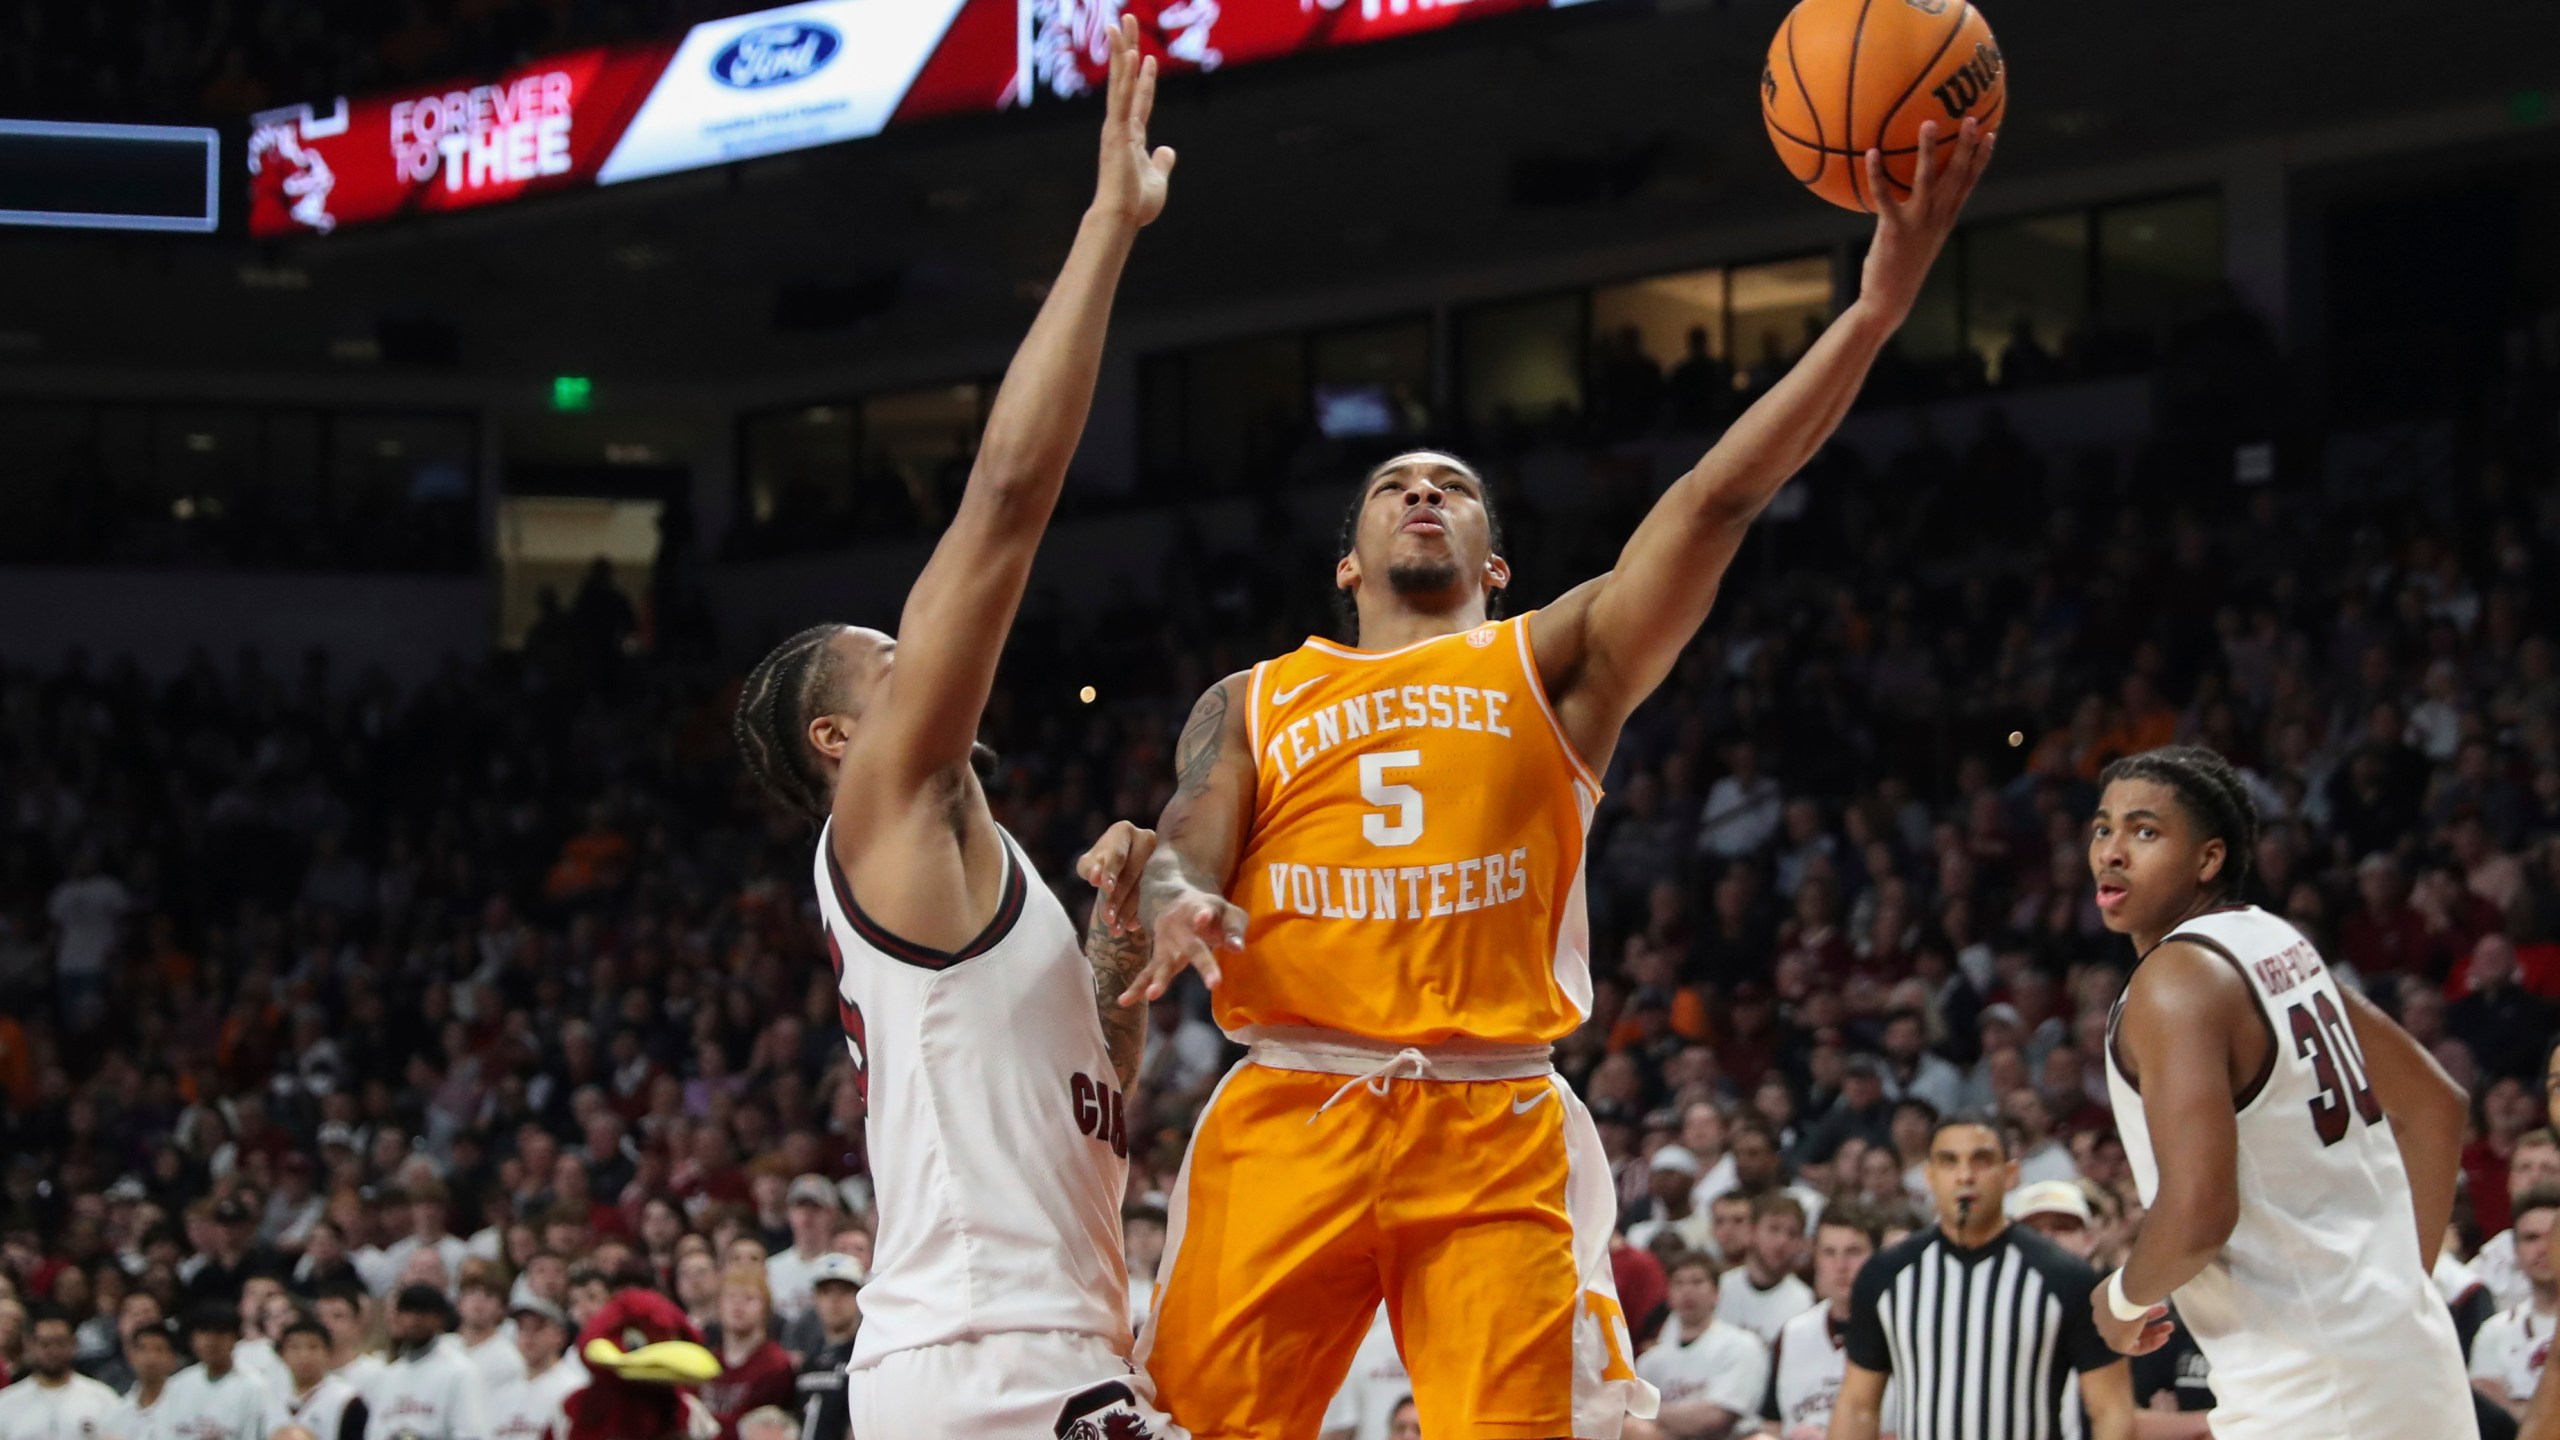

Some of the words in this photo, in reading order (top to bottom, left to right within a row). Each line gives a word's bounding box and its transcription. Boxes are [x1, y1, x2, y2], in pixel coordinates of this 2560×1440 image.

[728, 24, 823, 87] Ford
[390, 71, 573, 150] FOREVER
[394, 139, 440, 183] TO
[437, 114, 573, 193] THEE
[1267, 684, 1512, 785] TENNESSEE
[1358, 749, 1424, 848] 5
[1268, 846, 1528, 921] VOLUNTEERS
[2287, 989, 2383, 1148] 30
